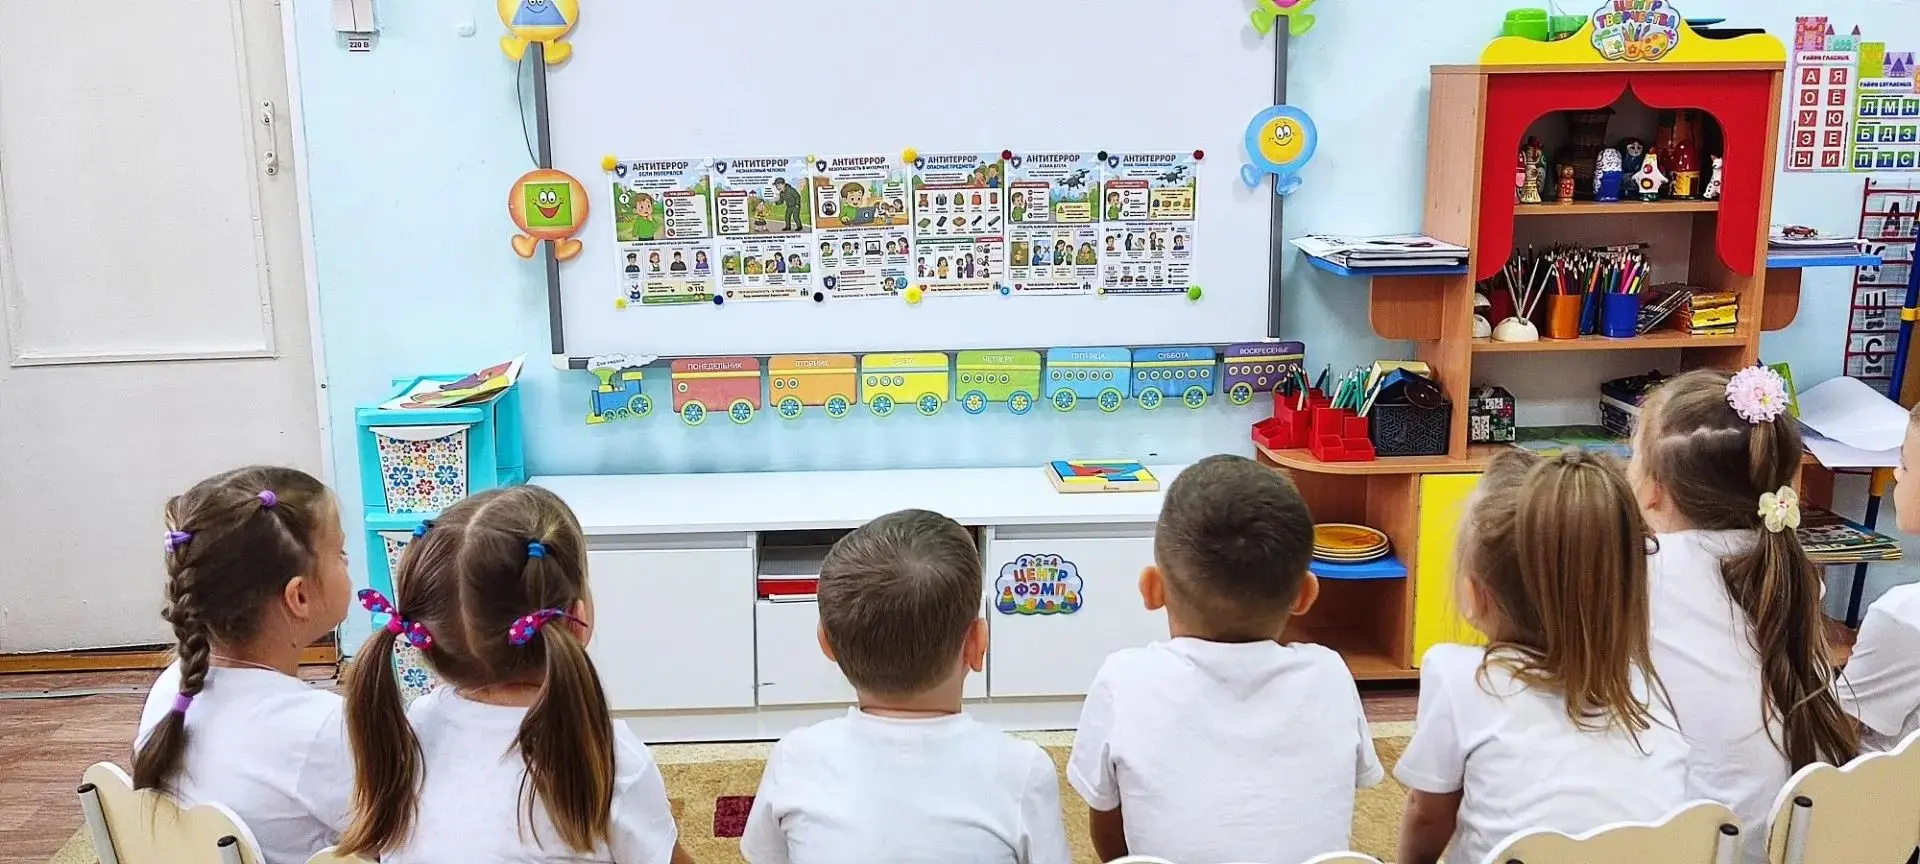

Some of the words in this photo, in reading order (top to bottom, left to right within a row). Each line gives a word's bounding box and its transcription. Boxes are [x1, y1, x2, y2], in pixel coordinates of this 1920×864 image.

[1614, 0, 1662, 11] ЦЕНТР
[1596, 11, 1676, 28] ТВОРЧЕСТВА
[1806, 71, 1816, 82] А
[1834, 71, 1843, 82] Я
[1804, 92, 1815, 103] О
[1864, 101, 1874, 113] Л
[1885, 101, 1896, 113] М
[1906, 101, 1915, 113] Н
[1804, 113, 1813, 123] У
[1828, 113, 1842, 124] Ю
[1802, 133, 1811, 144] Э
[1829, 133, 1838, 144] Е
[1861, 128, 1870, 140] Б
[1882, 128, 1892, 141] Д
[732, 159, 789, 168] АНТИТЕРРОР
[832, 157, 886, 166] АНТИТЕРРОР
[928, 156, 978, 164] АНТИТЕРРОР
[1026, 154, 1080, 162] АНТИТЕРРОР
[1797, 154, 1811, 164] Ы
[1826, 154, 1835, 164] И
[1859, 154, 1869, 166] П
[1882, 154, 1890, 165] Т
[1901, 154, 1910, 165] С
[632, 161, 689, 171] АНТИТЕРРОР
[1882, 202, 1900, 230] А
[1866, 338, 1882, 364] С
[1014, 567, 1068, 583] ЦЕНТР
[1014, 583, 1066, 596] ФЭМП
